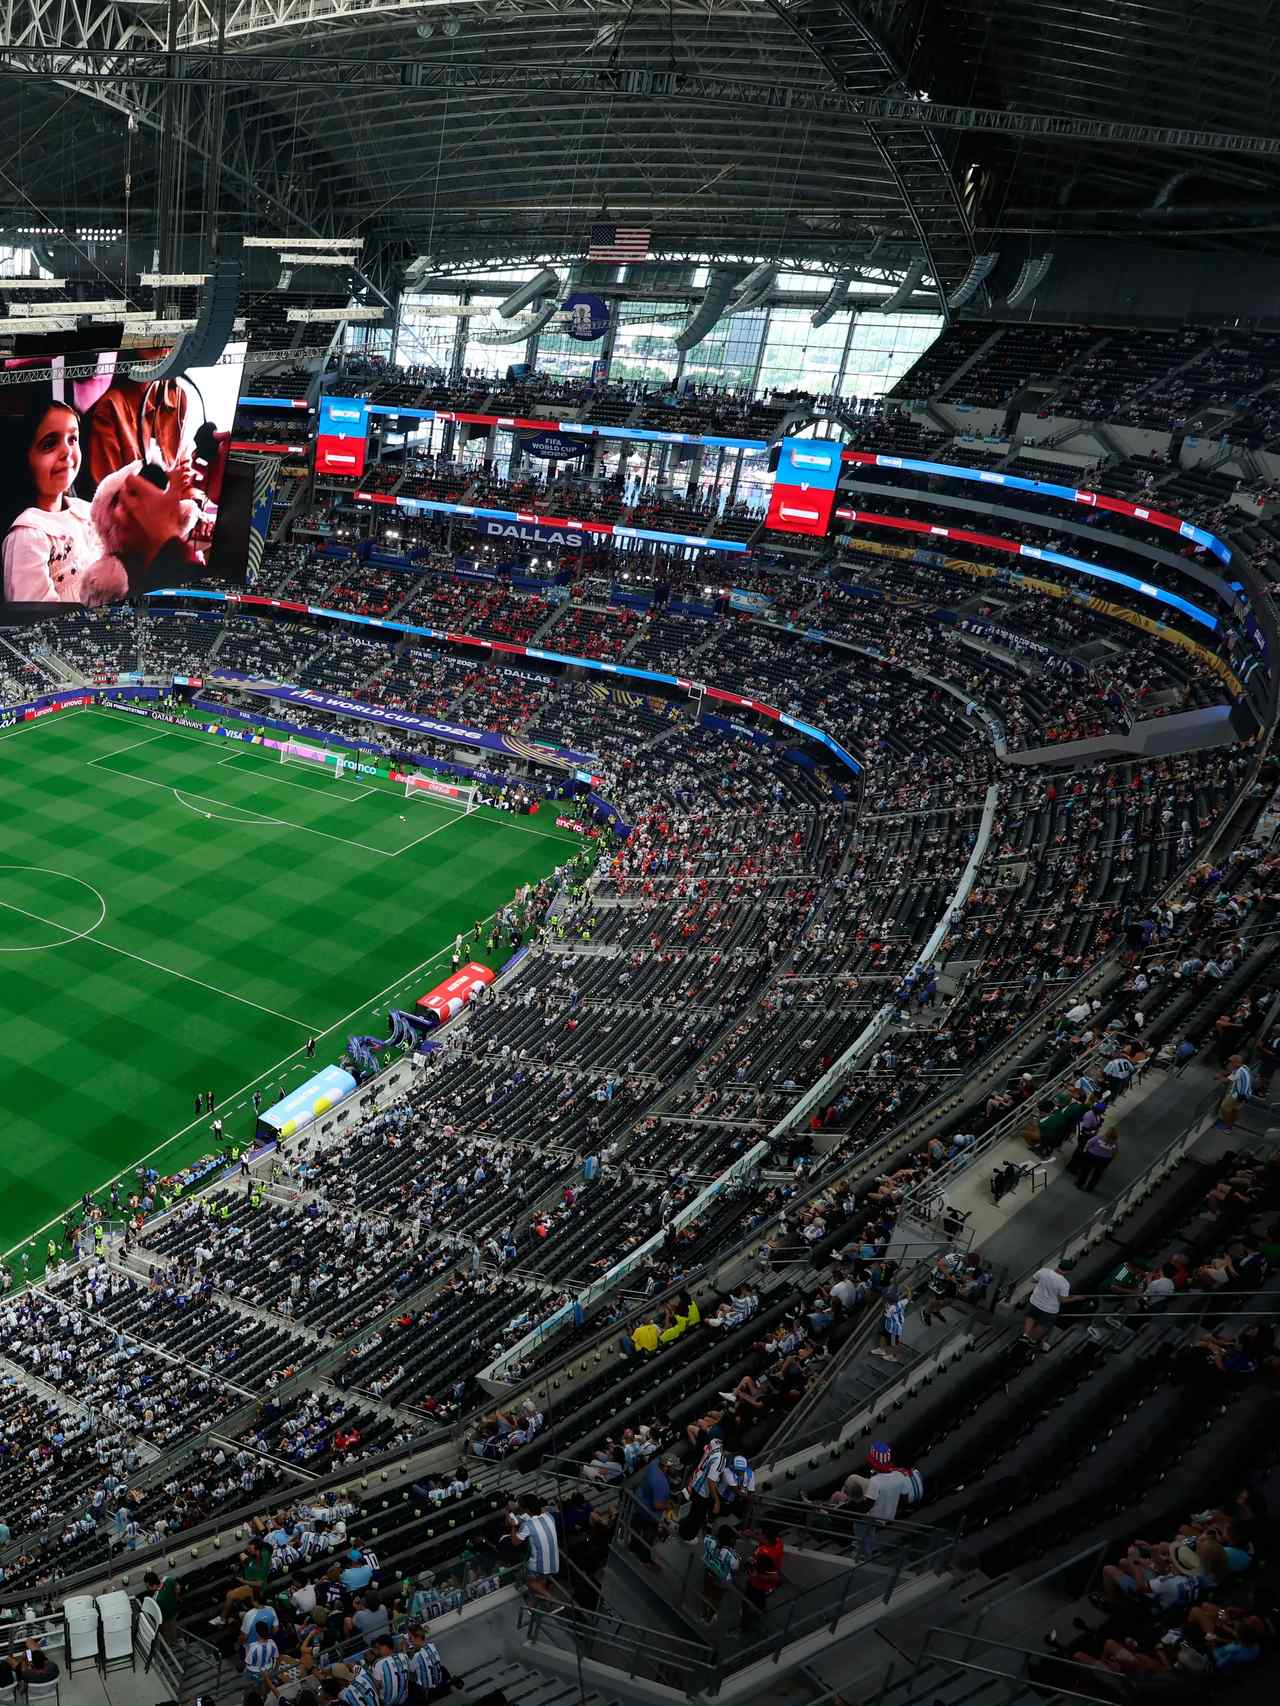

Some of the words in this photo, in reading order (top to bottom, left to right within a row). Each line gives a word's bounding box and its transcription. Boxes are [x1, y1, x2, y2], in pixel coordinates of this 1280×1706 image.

[532, 443, 560, 452] WORLD
[545, 438, 562, 446] FIFA
[487, 522, 583, 548] DALLAS
[504, 668, 552, 684] DALLAS
[151, 712, 174, 724] QATAR
[175, 716, 204, 730] AIRWAYS
[290, 688, 323, 702] FIFA
[326, 699, 385, 717] WORLD
[384, 712, 420, 725] CUP
[419, 721, 484, 739] 2026
[225, 728, 244, 741] VISA
